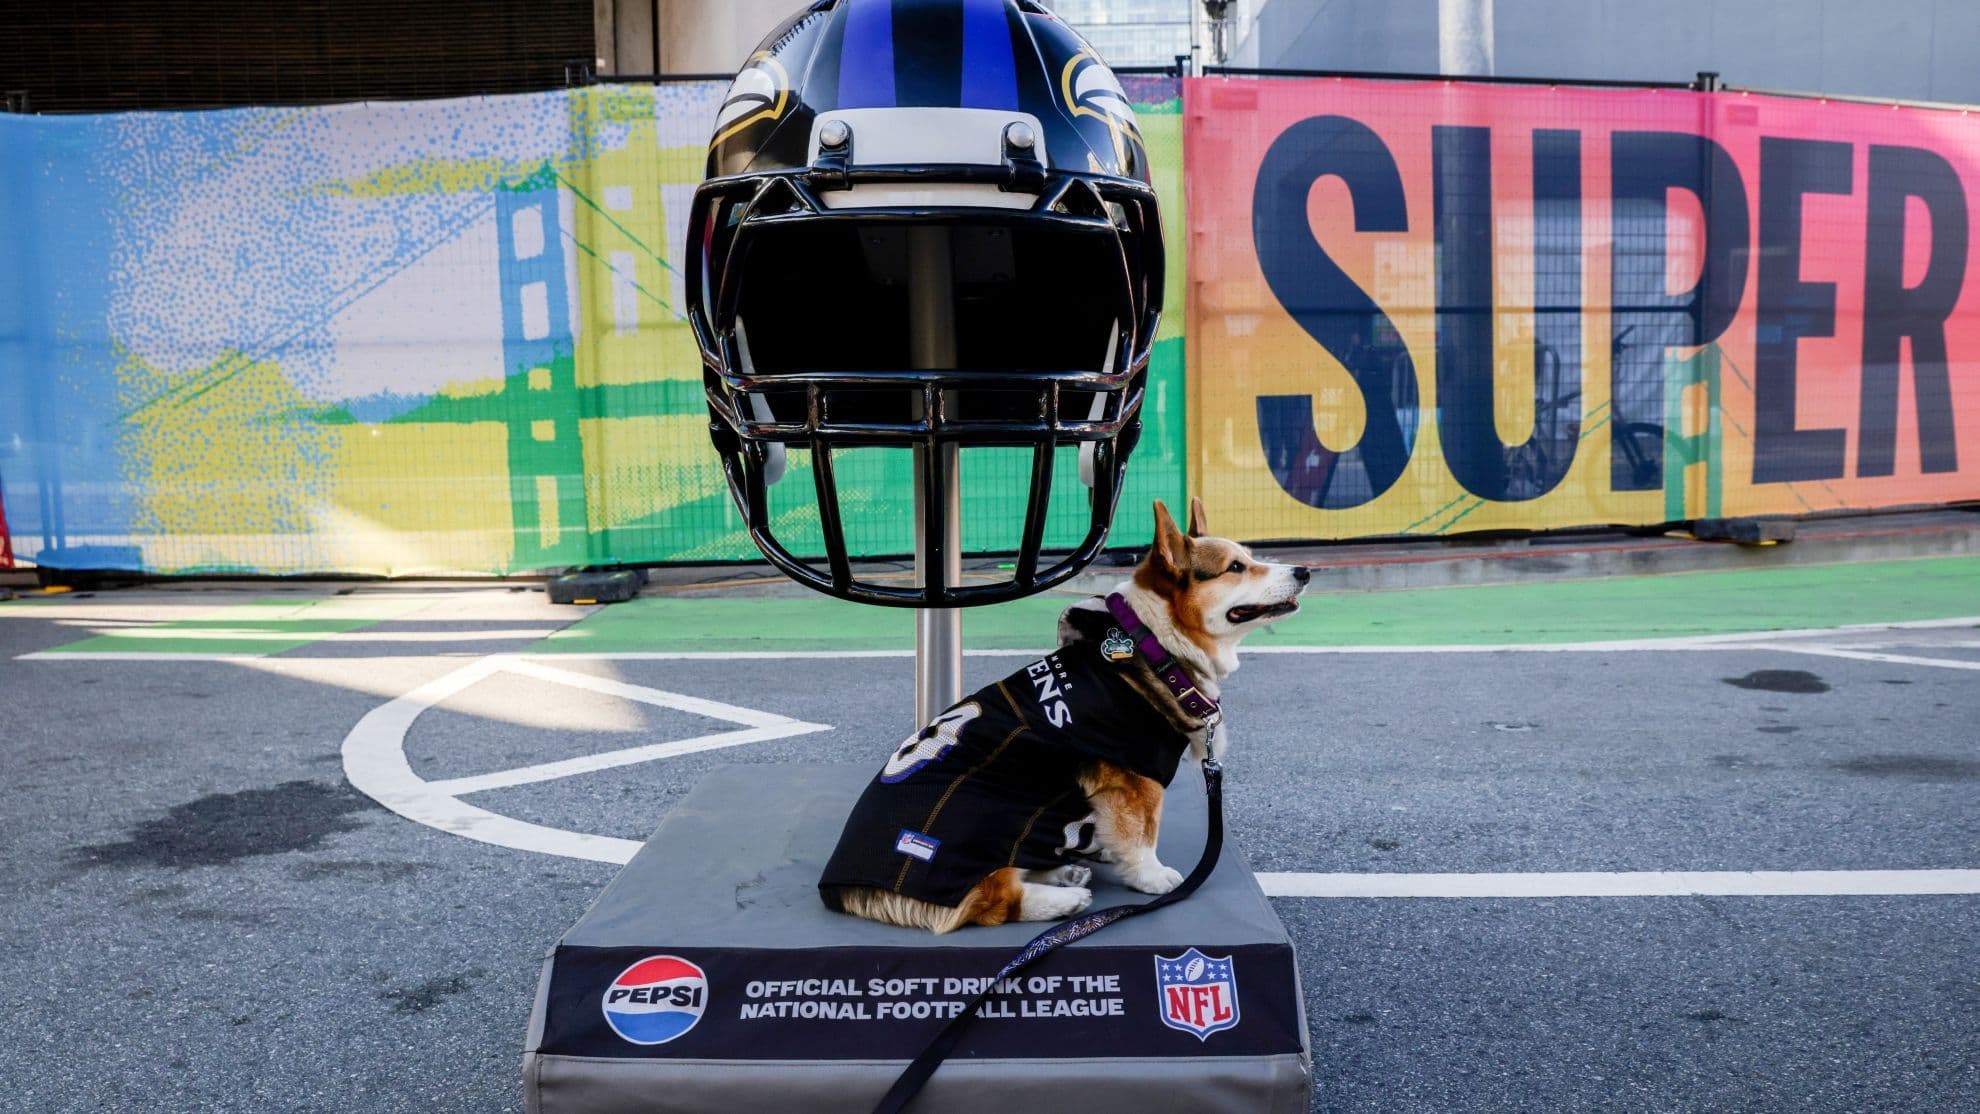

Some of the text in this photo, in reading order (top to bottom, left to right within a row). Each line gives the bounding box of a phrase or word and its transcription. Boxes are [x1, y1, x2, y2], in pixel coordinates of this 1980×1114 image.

[1251, 114, 1969, 511] SUPER
[607, 985, 702, 1008] PEPSI
[745, 974, 1121, 998] OFFICIAL SOFT DRINK OF THE
[739, 1001, 872, 1020] NATIONAL
[1021, 998, 1125, 1018] LEAGUE
[1166, 984, 1232, 1027] NFL
